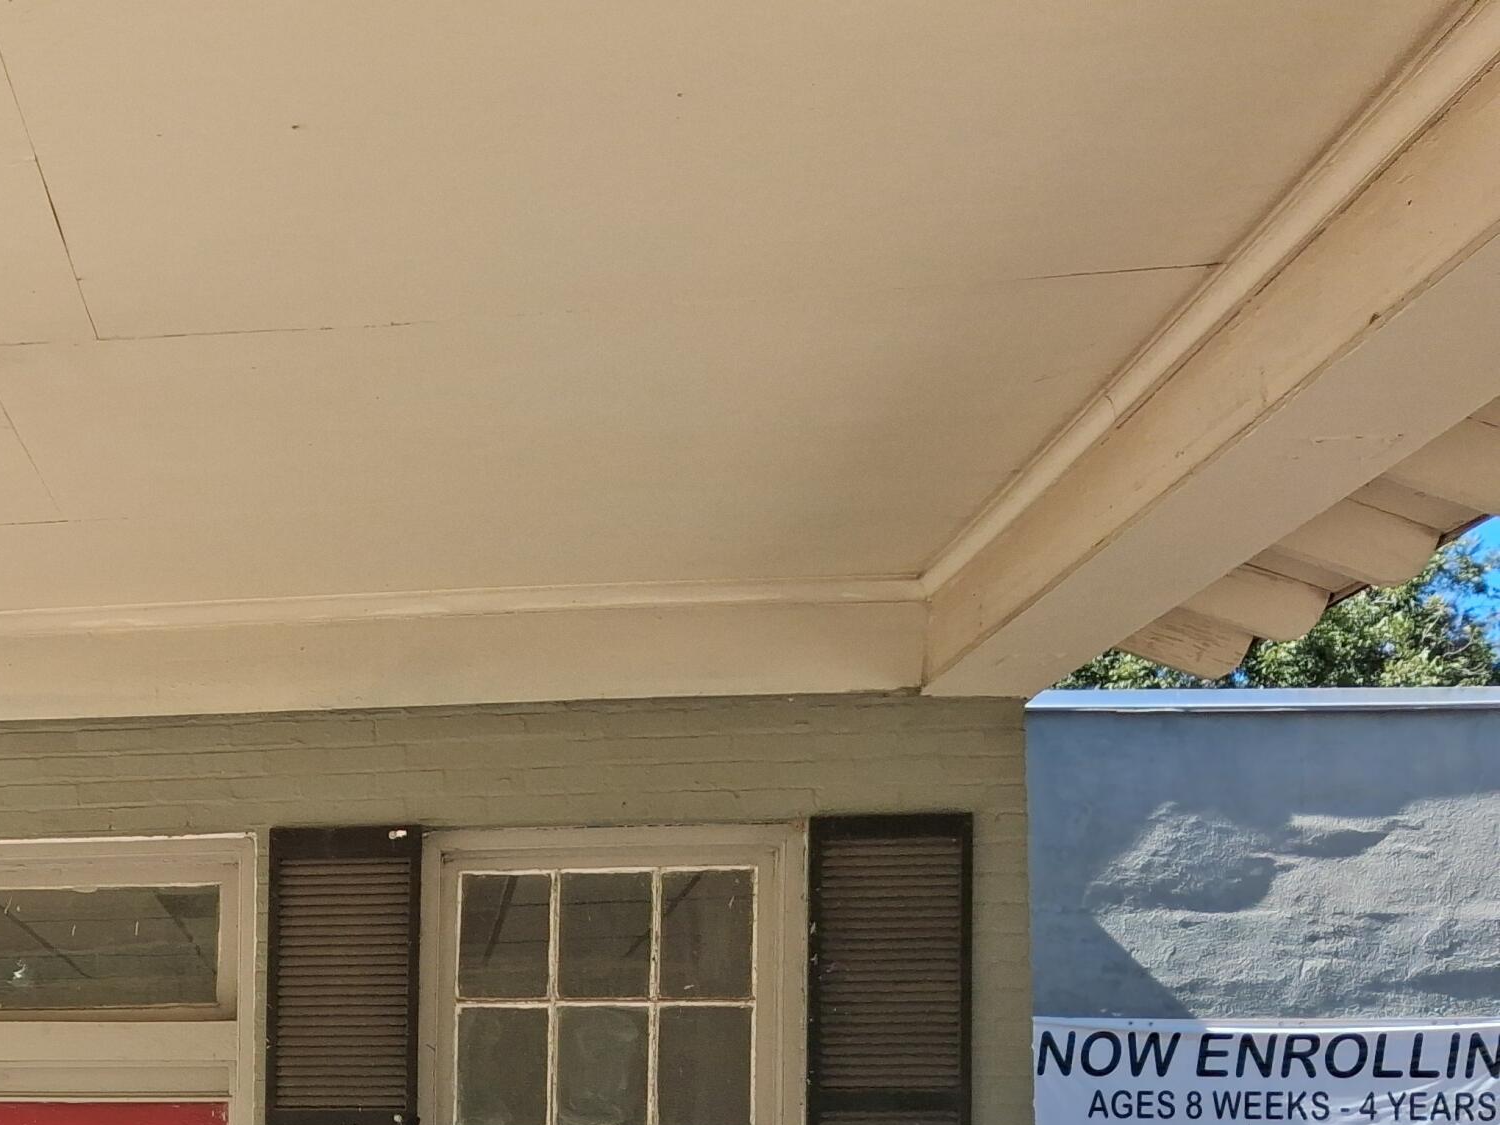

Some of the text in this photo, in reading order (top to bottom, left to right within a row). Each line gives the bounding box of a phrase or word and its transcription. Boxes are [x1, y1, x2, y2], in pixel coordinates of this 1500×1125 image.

[1037, 1031, 1500, 1079] NOW ENROLLIN
[1088, 1089, 1176, 1119] AGES
[1186, 1090, 1203, 1120] 8
[1212, 1090, 1330, 1121] WEEKS
[1359, 1091, 1377, 1121] 4
[1388, 1091, 1497, 1122] YEARS
